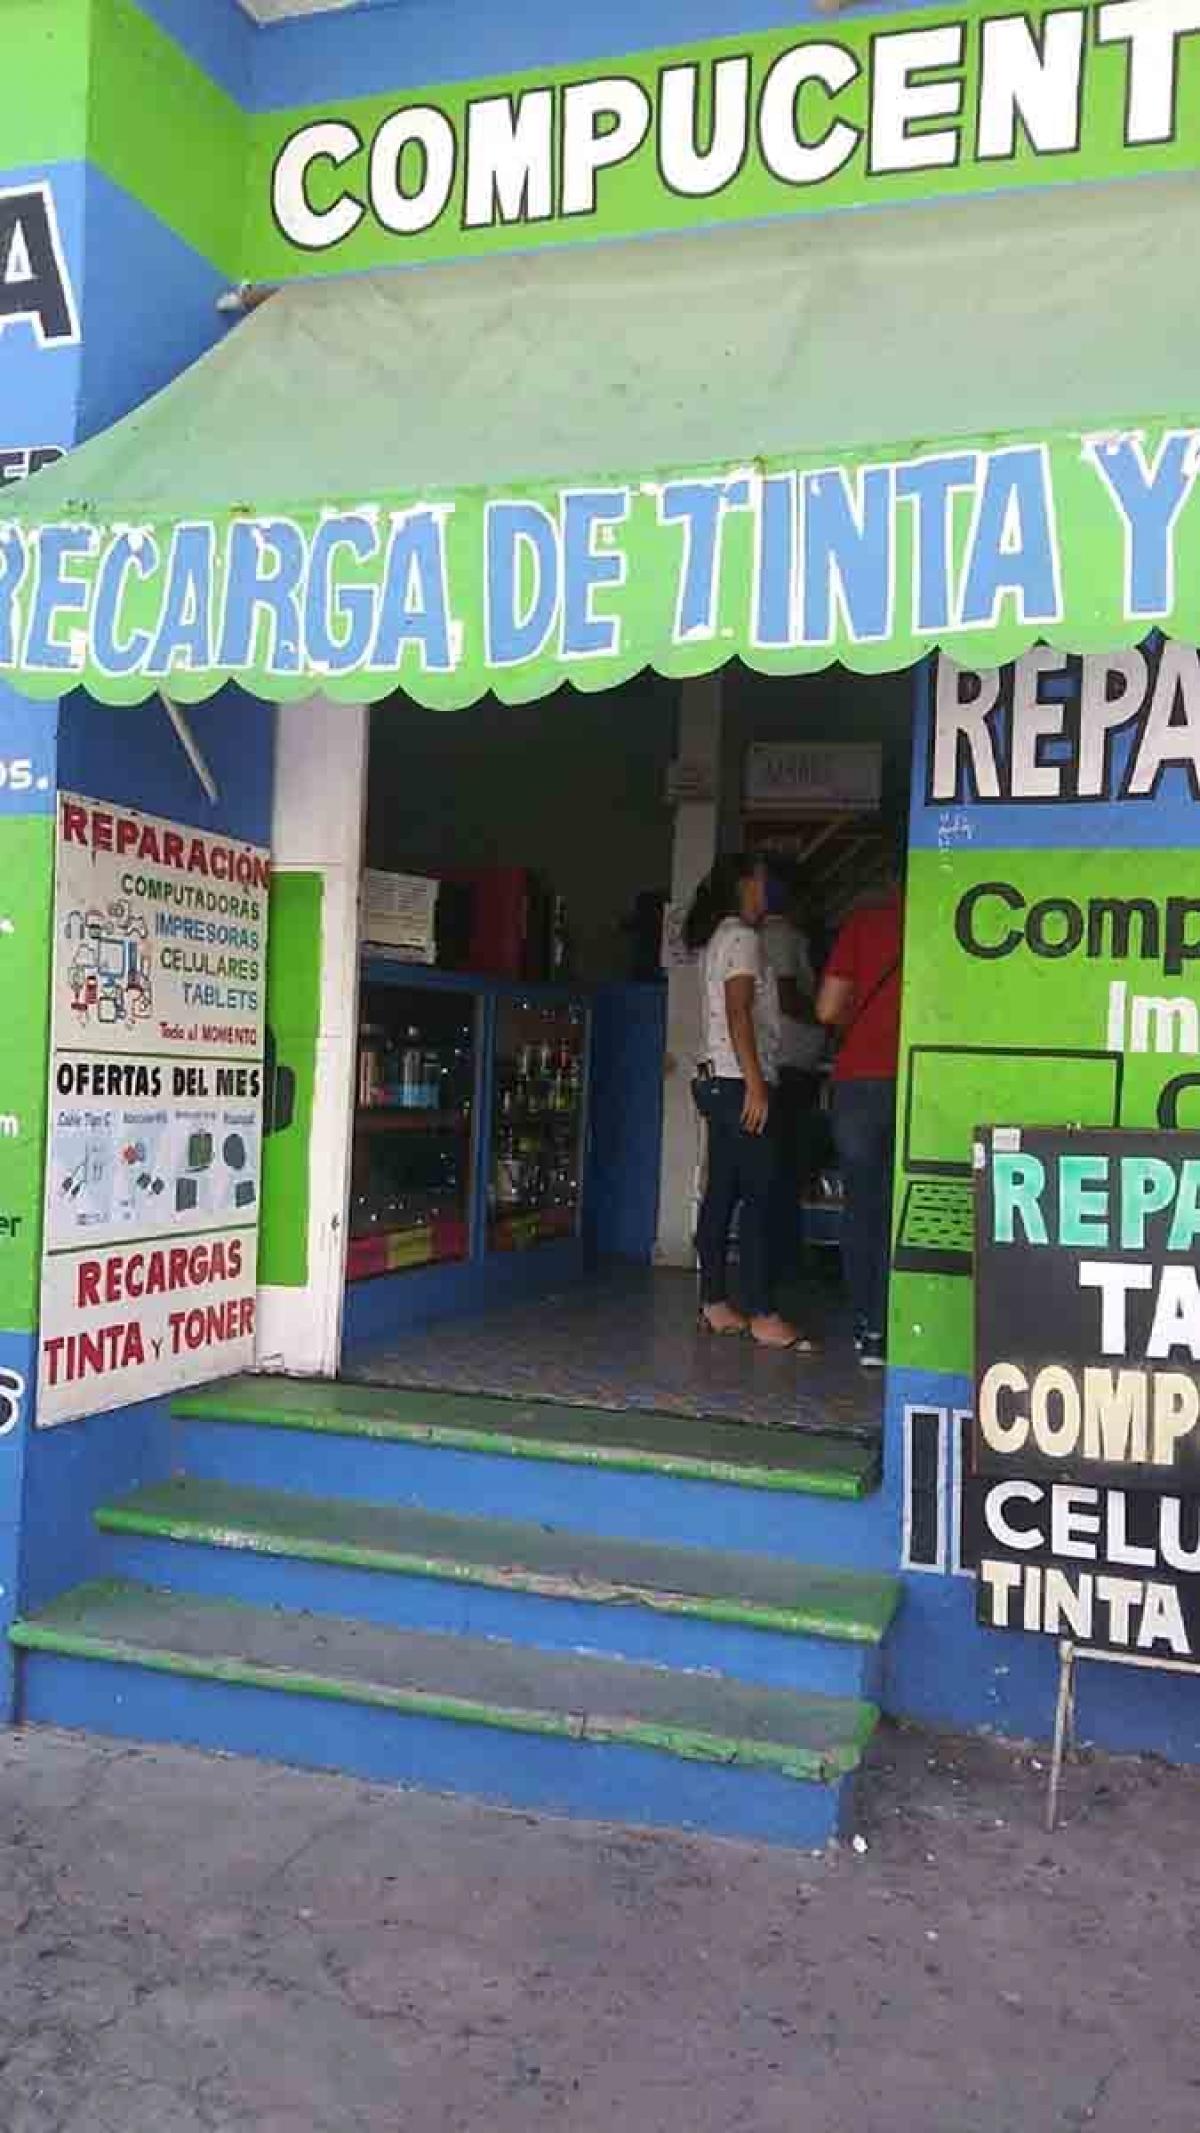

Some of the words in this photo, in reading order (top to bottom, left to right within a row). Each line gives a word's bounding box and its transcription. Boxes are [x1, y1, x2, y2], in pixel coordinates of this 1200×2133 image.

[271, 0, 1200, 250] COMPUCENT
[484, 488, 631, 670] DE
[658, 442, 1063, 649] TINTA
[1081, 428, 1200, 620] Y
[926, 640, 1200, 805] REPA
[121, 873, 260, 921] COMPUTADORAS
[154, 910, 259, 951] IMPRESORAS
[955, 882, 1200, 976] Comp
[160, 947, 259, 982] CELULARES
[182, 982, 258, 1011] TABLETS
[1108, 981, 1198, 1052] Im
[56, 1063, 162, 1097] OFERTAS
[172, 1067, 208, 1097] DEL
[216, 1068, 260, 1098] MES
[992, 1152, 1200, 1251] REPA
[77, 1238, 243, 1308] RECARGAS
[1078, 1261, 1200, 1360] TA
[43, 1321, 144, 1386] TINTA
[168, 1297, 256, 1354] TONER
[978, 1362, 1200, 1466] COMP
[984, 1480, 1200, 1573] CELU
[980, 1559, 1191, 1654] TINTA
